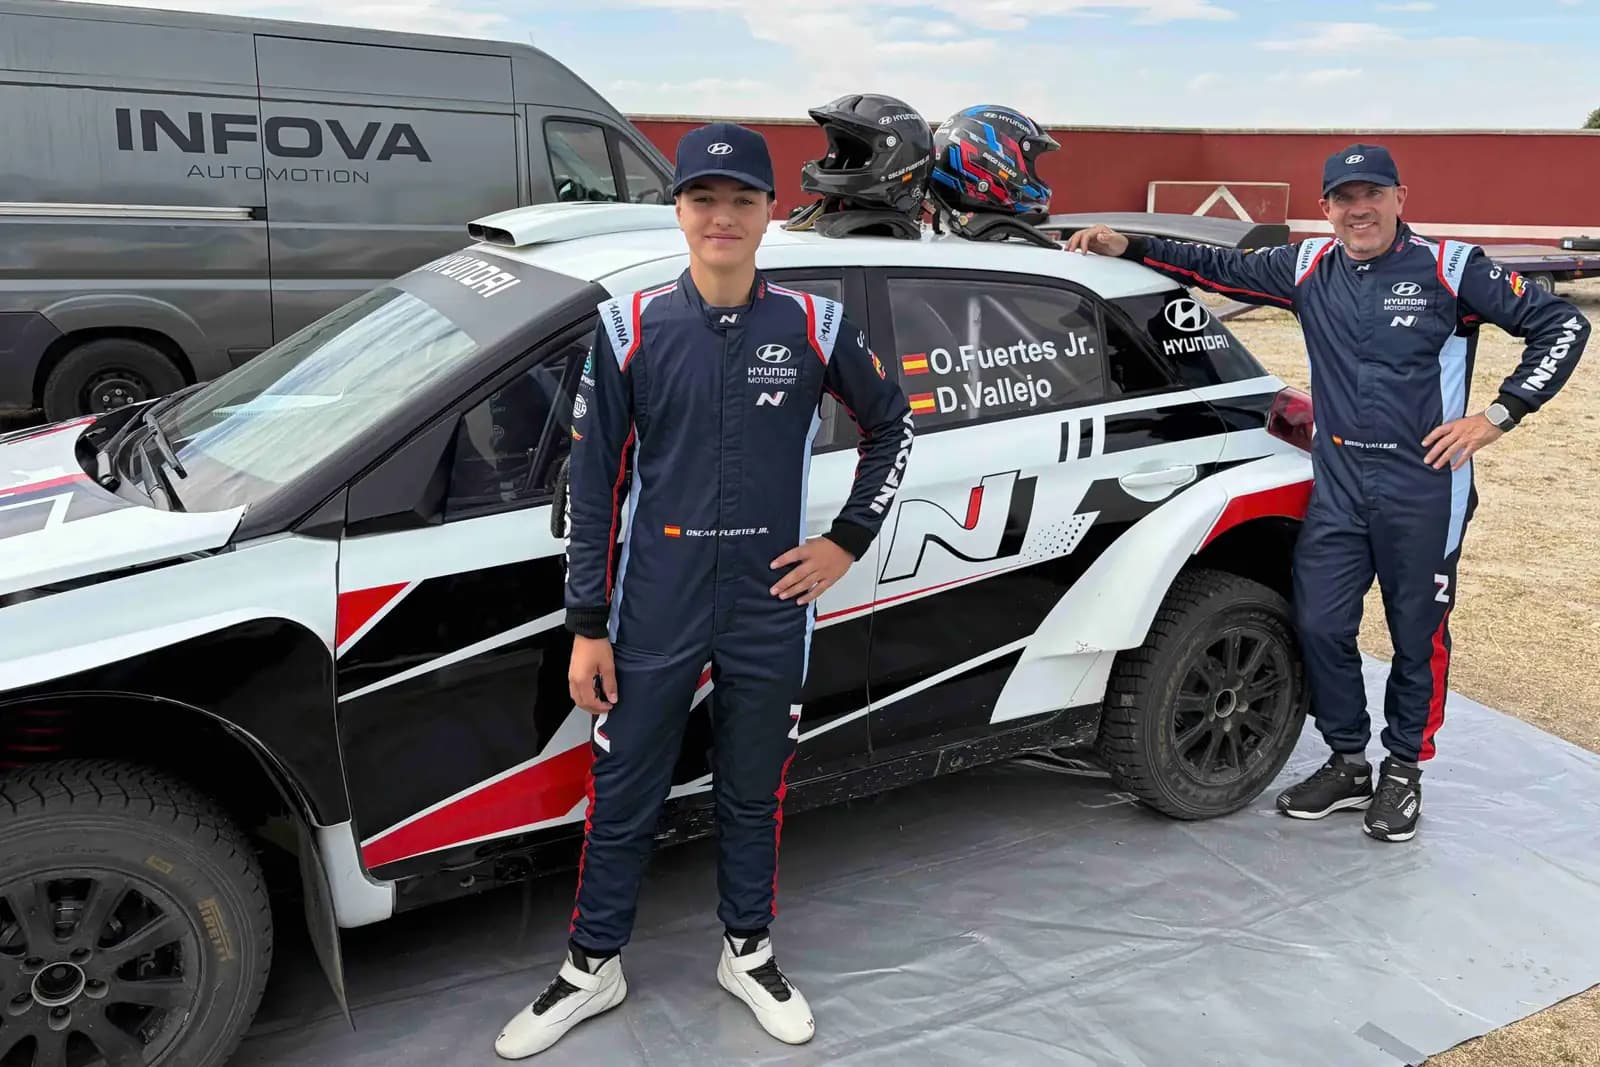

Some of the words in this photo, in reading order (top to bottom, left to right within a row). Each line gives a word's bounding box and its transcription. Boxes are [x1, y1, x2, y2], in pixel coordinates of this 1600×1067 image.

[115, 108, 432, 162] INFOVA
[187, 164, 369, 183] AUTOMOTION
[1064, 331, 1095, 358] Jr.
[1163, 334, 1230, 355] HYUNDAI
[1521, 316, 1582, 392] INFOVA
[748, 367, 797, 376] HYUNDAI
[748, 377, 796, 385] MOTORSPORT
[686, 529, 716, 537] OSCAR
[719, 527, 755, 537] FUERTES
